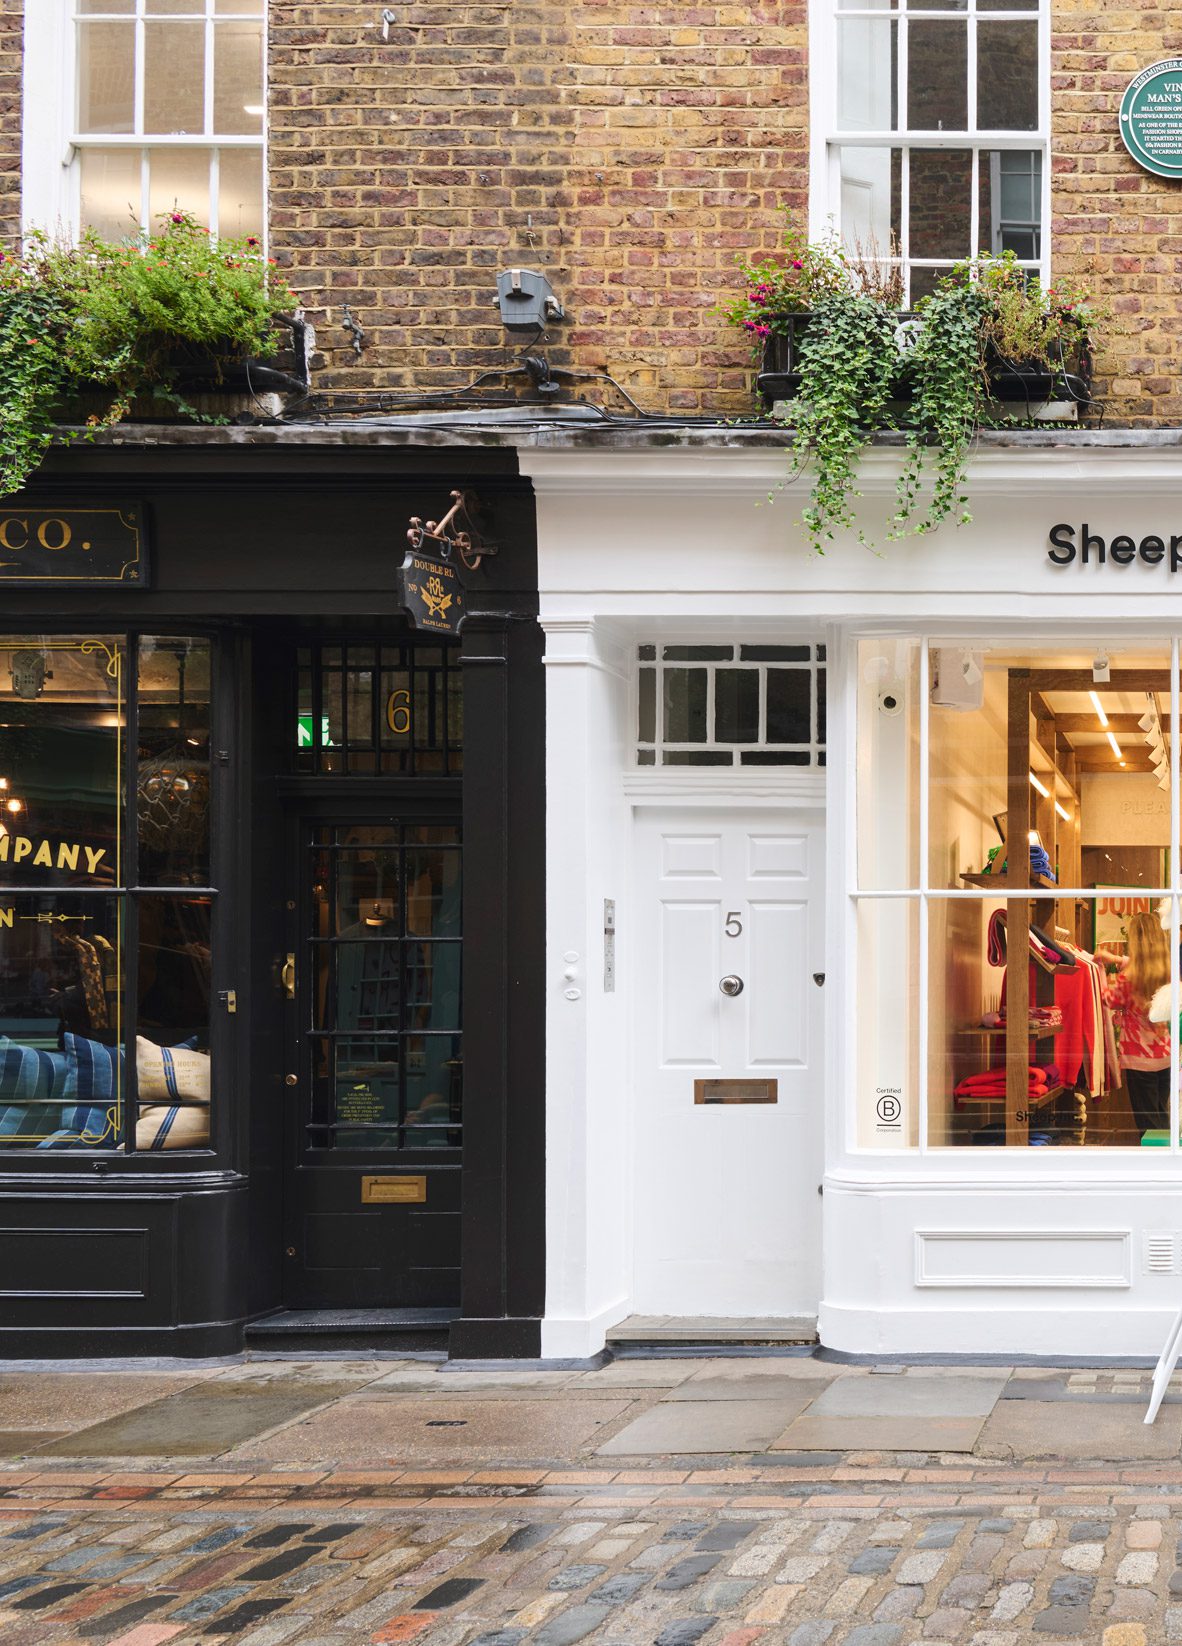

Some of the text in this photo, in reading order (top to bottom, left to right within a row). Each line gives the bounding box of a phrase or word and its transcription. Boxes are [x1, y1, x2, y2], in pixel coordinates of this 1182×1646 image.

[1132, 61, 1179, 89] WESTMINSTER
[1147, 94, 1181, 103] MAN'S
[0, 518, 91, 550] CO.
[414, 559, 454, 578] DOUBLE RL
[387, 689, 410, 734] 6
[1098, 897, 1149, 915] JOIN
[725, 911, 743, 938] 5
[883, 1100, 895, 1117] B
